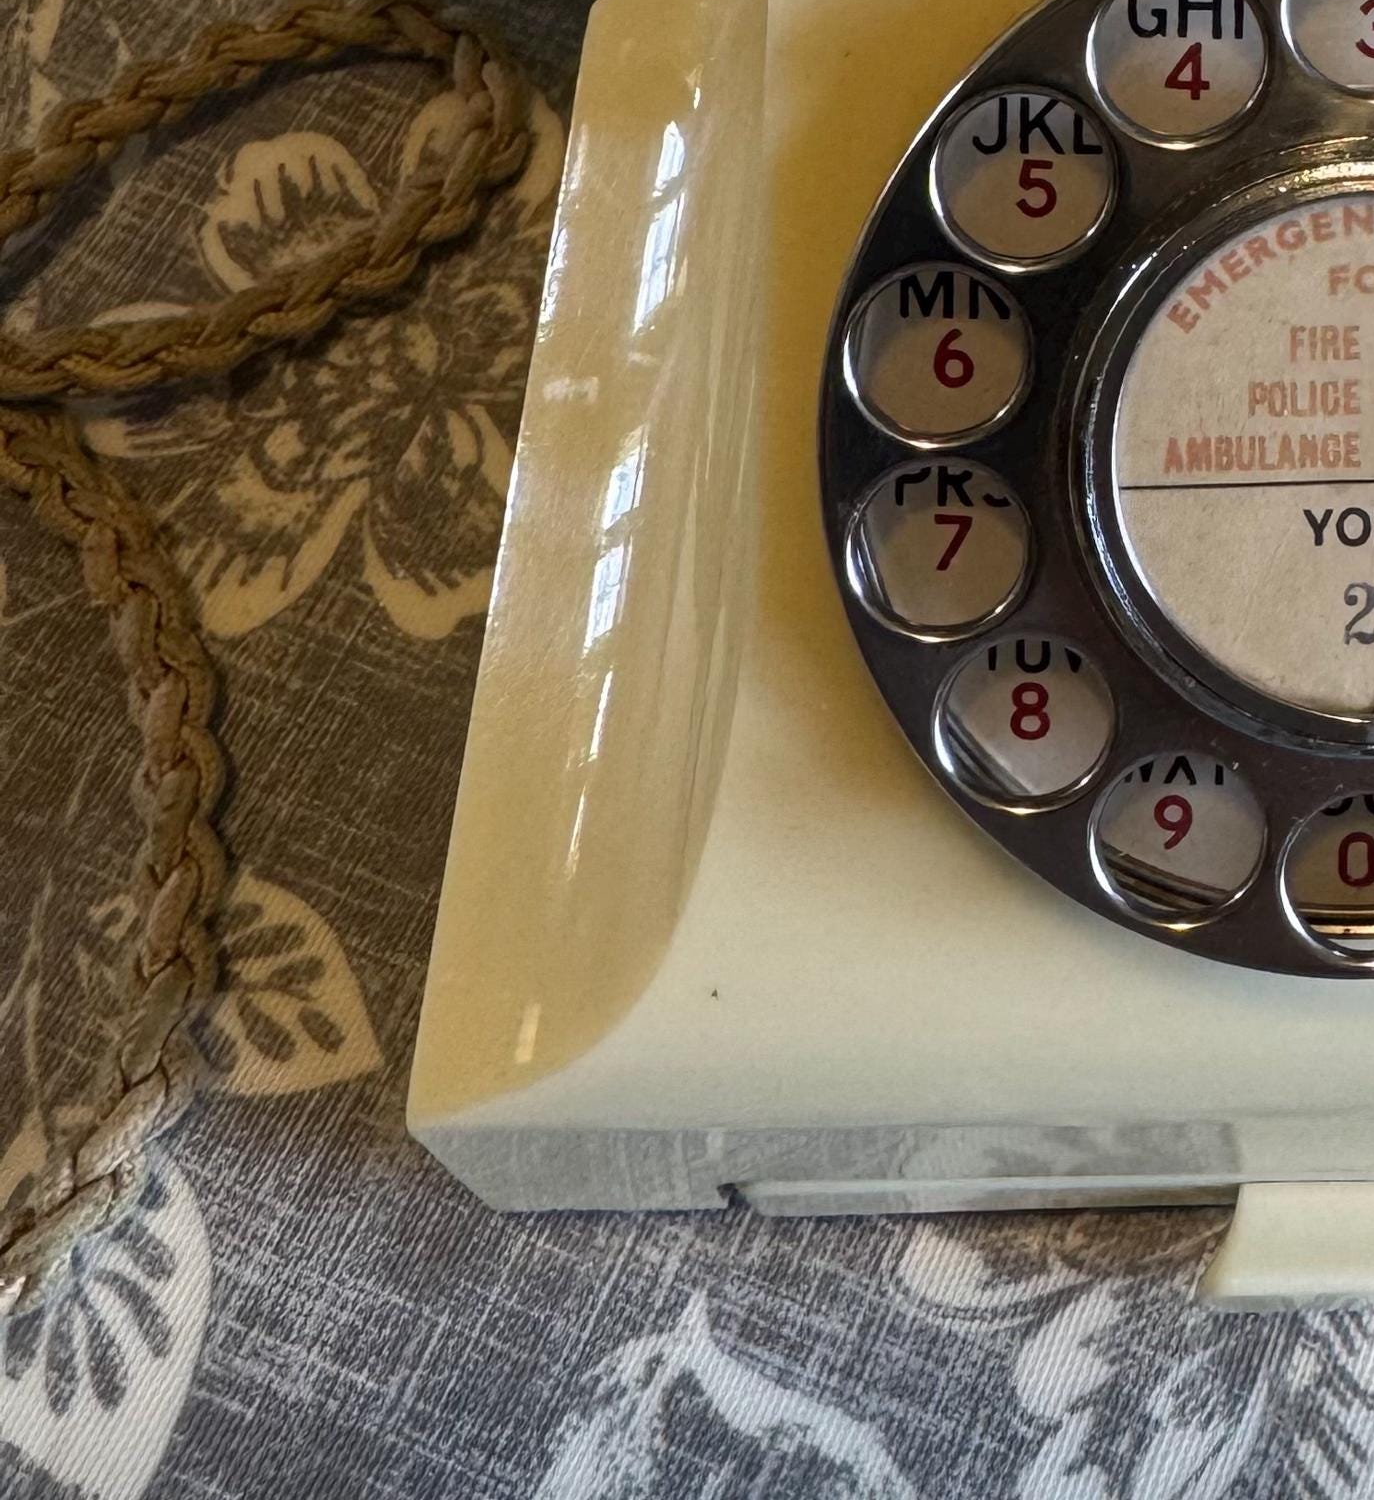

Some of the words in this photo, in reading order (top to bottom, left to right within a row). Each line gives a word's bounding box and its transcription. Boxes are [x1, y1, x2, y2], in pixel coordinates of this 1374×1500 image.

[1164, 42, 1210, 100] 4
[972, 97, 1103, 155] JKL
[1015, 159, 1057, 218] 5
[933, 328, 974, 389] 6
[1289, 324, 1361, 362] FIRE
[1247, 380, 1362, 417] POLICE
[1164, 433, 1362, 474] AMBULANCE
[933, 513, 974, 573] 7
[1010, 682, 1050, 740] 8
[1153, 794, 1193, 850] 9
